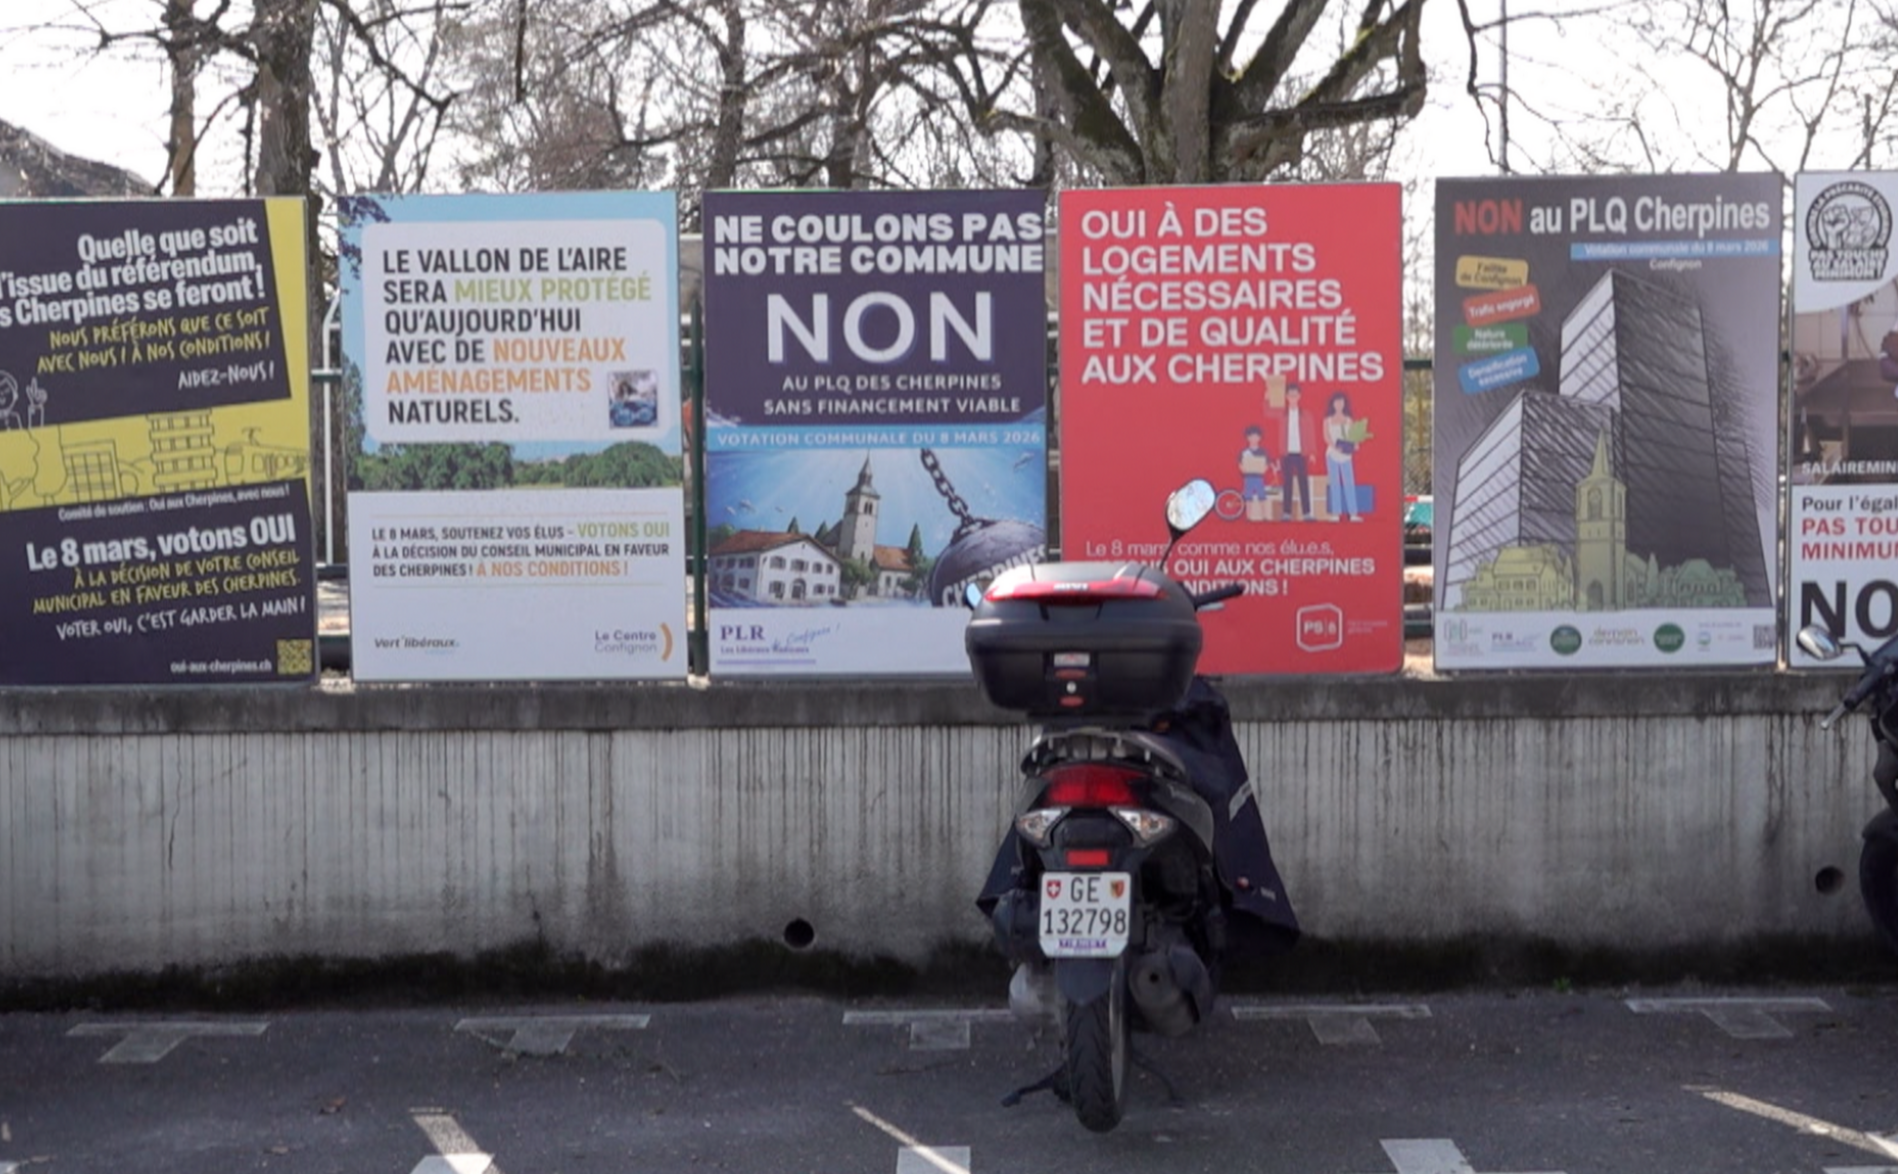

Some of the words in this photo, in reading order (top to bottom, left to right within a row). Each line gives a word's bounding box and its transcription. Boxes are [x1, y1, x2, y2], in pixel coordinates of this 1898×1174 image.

[715, 216, 762, 243] NE
[771, 214, 953, 242] COULONS
[963, 213, 1042, 241] PAS
[1081, 209, 1146, 239] OUI
[1158, 202, 1183, 237] À
[1194, 207, 1268, 237] DES
[1454, 199, 1523, 234] NON
[1530, 206, 1561, 233] au
[1570, 198, 1627, 235] PLQ
[1635, 195, 1770, 239] Cherpines
[78, 230, 155, 262] Quelle
[160, 230, 204, 257] que
[210, 217, 258, 246] soit
[76, 264, 109, 290] du
[114, 250, 260, 286] référendum,
[383, 250, 409, 274] LE
[418, 249, 510, 273] VALLON
[520, 248, 549, 272] DE
[558, 247, 627, 271] L'AIRE
[714, 247, 841, 274] NOTRE
[851, 245, 1043, 274] COMMUNE
[1083, 243, 1316, 275] LOGEMENTS
[1649, 259, 1702, 271] Confignon
[384, 280, 447, 304] SERA
[454, 278, 531, 303] MIEUX
[542, 271, 651, 302] PROTÉGÉ
[1083, 275, 1342, 312] NÉCESSAIRES
[16, 290, 139, 324] Cherpines
[144, 290, 171, 310] se
[385, 308, 581, 336] QU'AUJOURD'HUI
[768, 291, 991, 363] NON
[1084, 319, 1128, 348] ET
[1142, 318, 1188, 347] DE
[1200, 308, 1356, 346] QUALITÉ
[38, 354, 74, 374] AVEC
[132, 340, 142, 362] À
[147, 342, 174, 360] NOS
[386, 340, 446, 364] AVEC
[455, 339, 484, 363] DE
[494, 338, 626, 362] NOUVEAUX
[386, 362, 591, 394] AMÉNAGEMENTS
[1082, 354, 1156, 384] AUX
[1168, 351, 1384, 383] CHERPINES
[783, 376, 808, 391] AU
[815, 376, 852, 393] PLQ
[857, 375, 890, 390] DES
[896, 374, 1001, 390] CHERPINES
[388, 399, 520, 424] NATURELS.
[764, 400, 811, 415] SANS
[818, 399, 950, 414] FINANCEMENT
[957, 398, 1020, 412] VIABLE
[718, 432, 801, 445] VOTATION
[806, 432, 906, 445] COMMUNALE
[913, 431, 934, 444] DU
[940, 431, 947, 444] 8
[953, 431, 997, 444] MARS
[1004, 431, 1039, 443] 2026
[59, 504, 92, 521] Comité
[94, 502, 106, 518] de
[109, 500, 140, 516] soutien
[150, 498, 164, 512] Oui
[166, 499, 184, 509] aux
[186, 491, 236, 508] Cherpines,
[238, 488, 258, 501] avec
[1802, 496, 1842, 511] Pour
[372, 528, 385, 541] LE
[390, 529, 396, 541] 8
[400, 528, 438, 542] MARS,
[442, 527, 503, 540] SOUTENEZ
[507, 527, 530, 540] VOS
[534, 523, 564, 539] ÉLUS
[577, 523, 638, 538] VOTONS
[644, 523, 670, 537] OUI
[1802, 517, 1845, 535] PAS
[27, 543, 57, 570] Le
[61, 538, 78, 565] 8
[84, 536, 155, 564] mars,
[157, 526, 246, 556] votons
[250, 514, 296, 545] OUI
[372, 542, 380, 558] À
[384, 546, 399, 559] LA
[402, 543, 457, 558] DÉCISION
[462, 545, 477, 558] DU
[481, 544, 531, 557] CONSEIL
[535, 544, 600, 557] MUNICIPAL
[605, 544, 620, 556] EN
[624, 543, 669, 556] FAVEUR
[1086, 541, 1107, 557] Le
[1111, 541, 1122, 556] 8
[1178, 543, 1239, 556] comme
[1245, 542, 1275, 555] nos
[373, 564, 395, 577] DES
[477, 560, 486, 576] À
[491, 561, 522, 576] NOS
[1174, 559, 1208, 575] OUI
[1215, 559, 1254, 574] AUX
[1260, 557, 1374, 574] CHERPINES
[34, 591, 104, 614] MUNICIPAL
[112, 589, 130, 606] EN
[137, 581, 191, 604] FAVEUR
[196, 578, 219, 596] DES
[595, 631, 609, 641] Le
[614, 630, 656, 641] Centre
[720, 625, 764, 640] PLR
[595, 642, 657, 654] Confignon
[1071, 876, 1101, 903] GE
[1044, 908, 1126, 935] 132798
